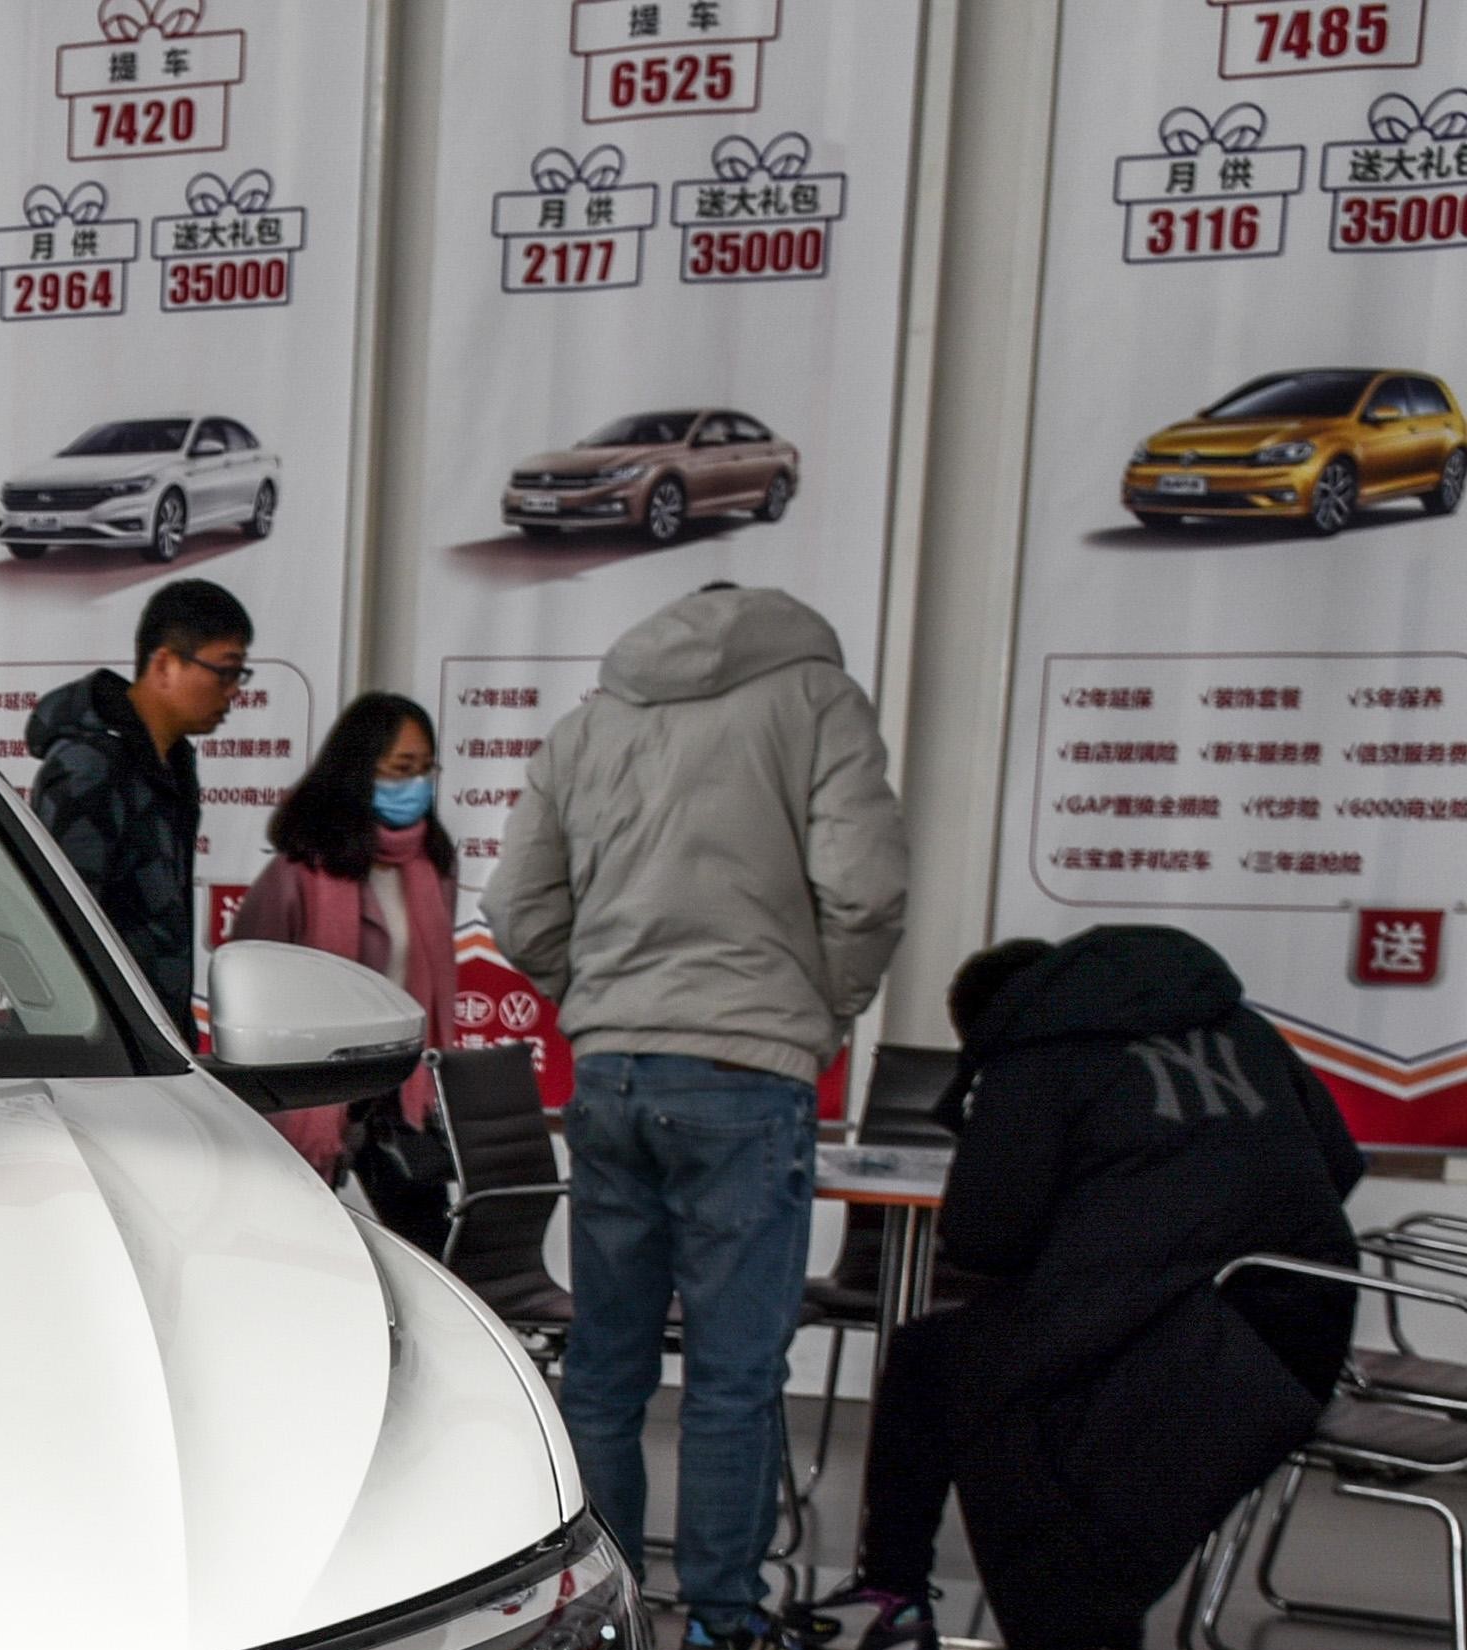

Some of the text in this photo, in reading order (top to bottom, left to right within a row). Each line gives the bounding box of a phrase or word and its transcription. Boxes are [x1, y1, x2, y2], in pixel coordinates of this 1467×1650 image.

[1255, 5, 1388, 62] 7485
[109, 49, 190, 82] 提车
[609, 54, 733, 108] 6525
[93, 98, 195, 148] 7420
[1165, 159, 1254, 193] 月供
[539, 197, 614, 228] 月供
[696, 186, 820, 219] 送大礼包
[30, 230, 99, 260] 月供
[173, 218, 283, 251] 送大礼包
[691, 228, 823, 275] 35000
[1147, 205, 1260, 254] 3116
[168, 259, 287, 305] 35000
[523, 240, 616, 285] 2177
[14, 270, 113, 313] 2964
[1370, 920, 1426, 973] 送
